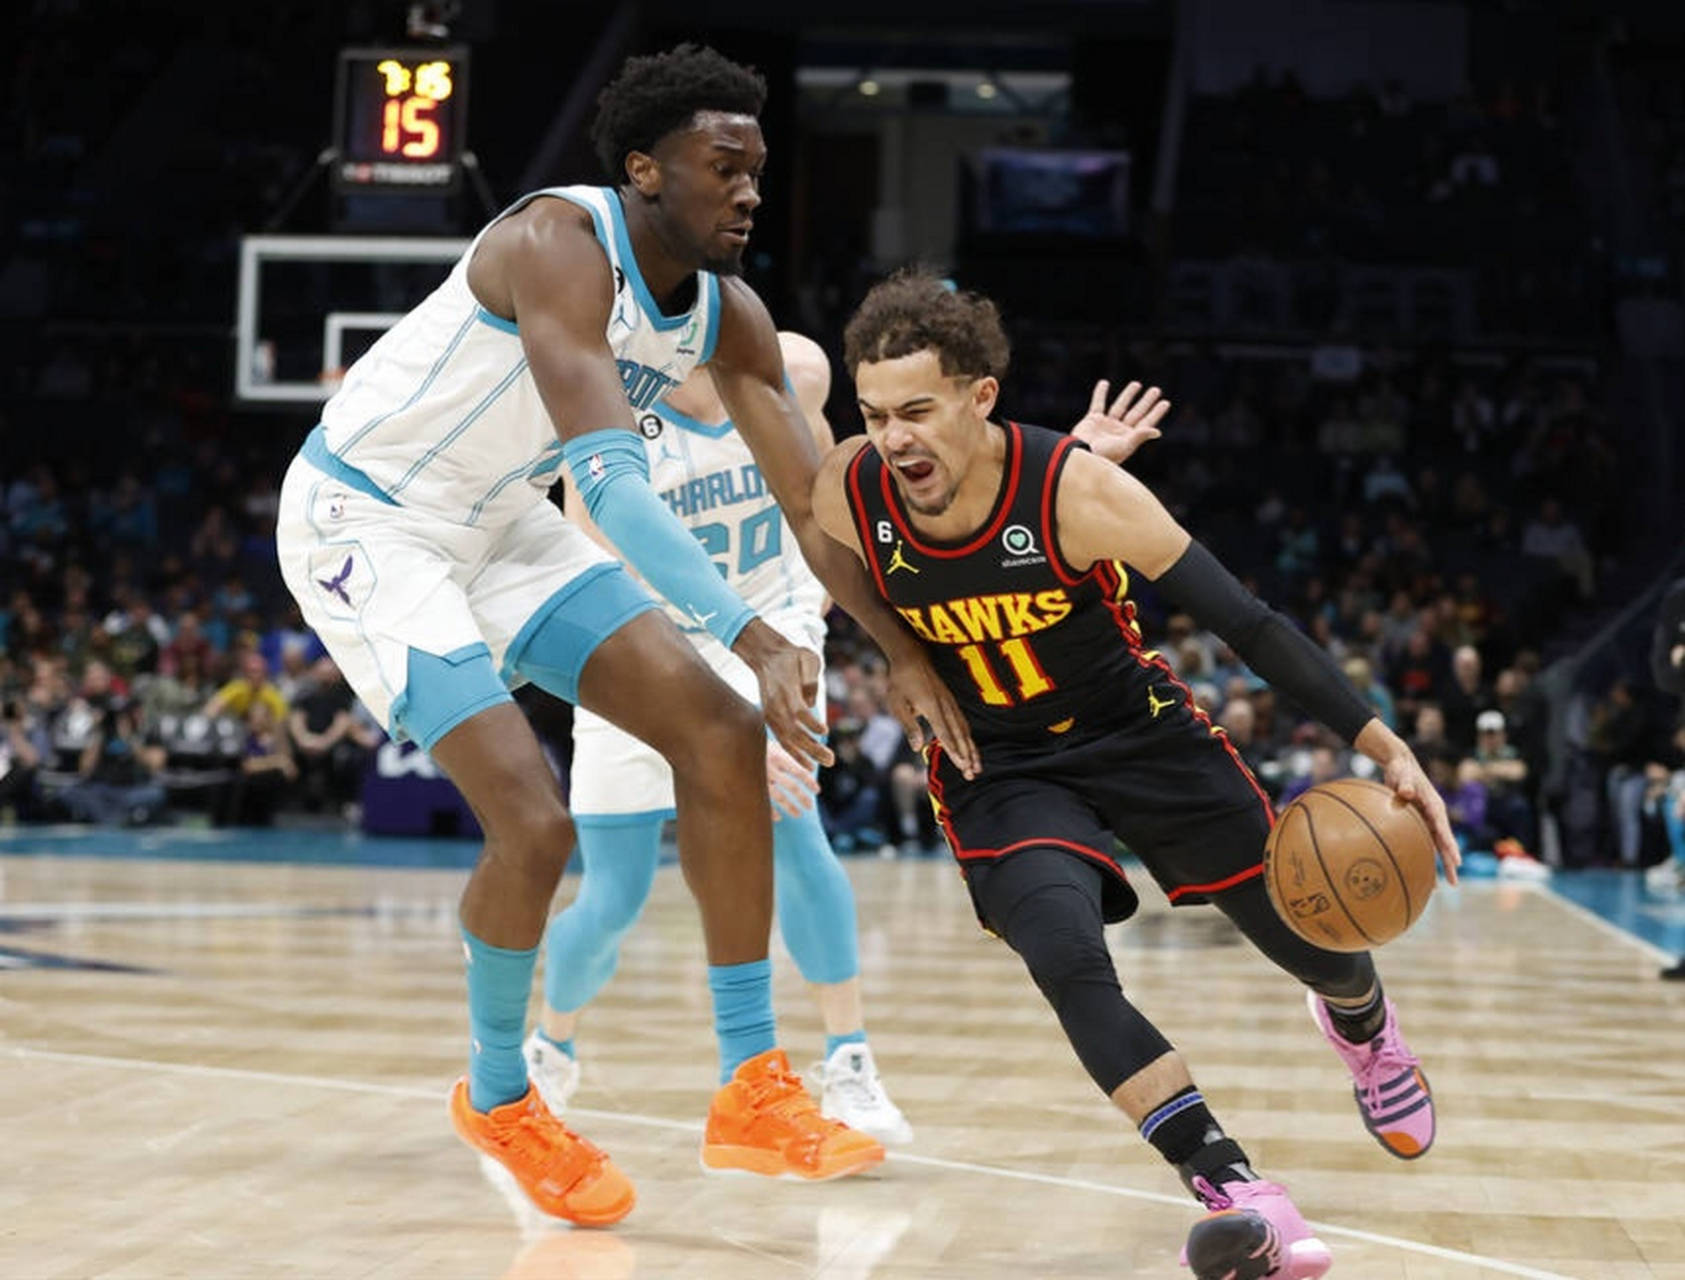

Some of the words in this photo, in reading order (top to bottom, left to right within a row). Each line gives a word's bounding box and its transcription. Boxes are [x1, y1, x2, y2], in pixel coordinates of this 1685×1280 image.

[383, 97, 439, 157] 15
[659, 475, 770, 517] HARLO
[877, 520, 893, 543] 6
[896, 588, 1073, 645] HAWKS
[957, 636, 1057, 708] 11
